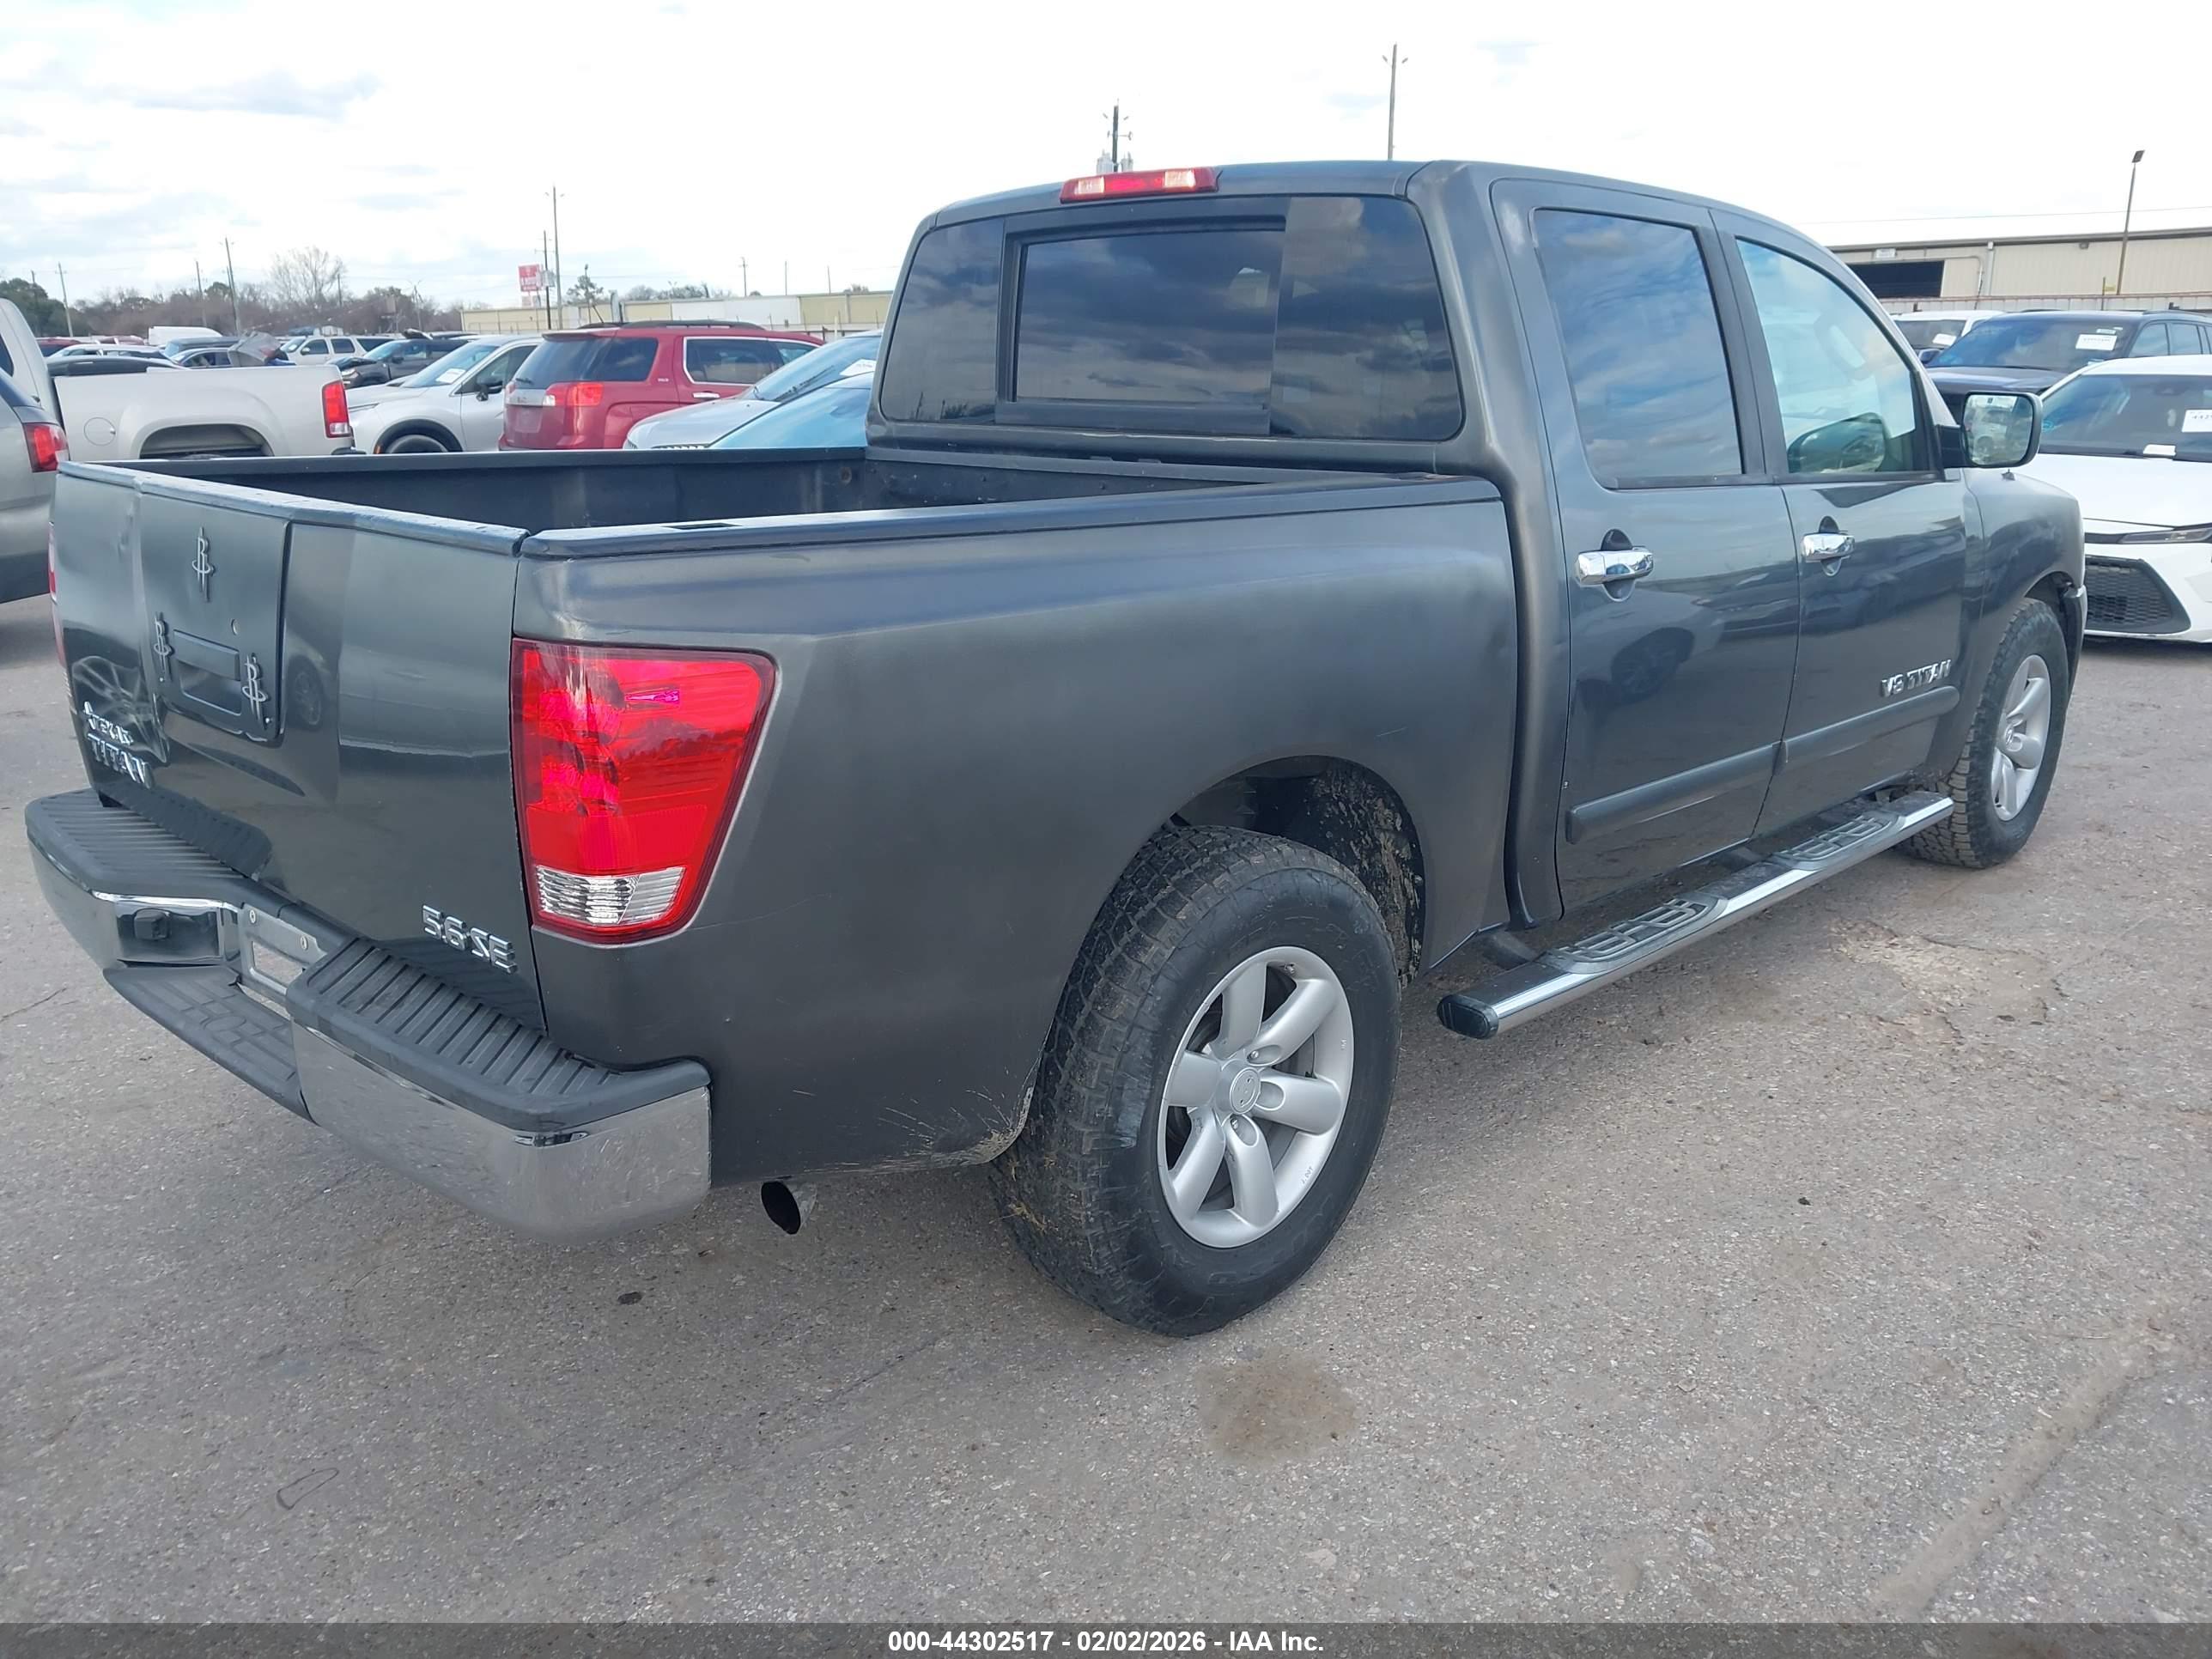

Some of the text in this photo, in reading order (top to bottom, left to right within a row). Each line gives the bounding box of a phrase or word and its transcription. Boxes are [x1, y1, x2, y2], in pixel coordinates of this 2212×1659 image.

[1881, 659, 1951, 696] V8 TITAN
[88, 733, 151, 789] TITAN
